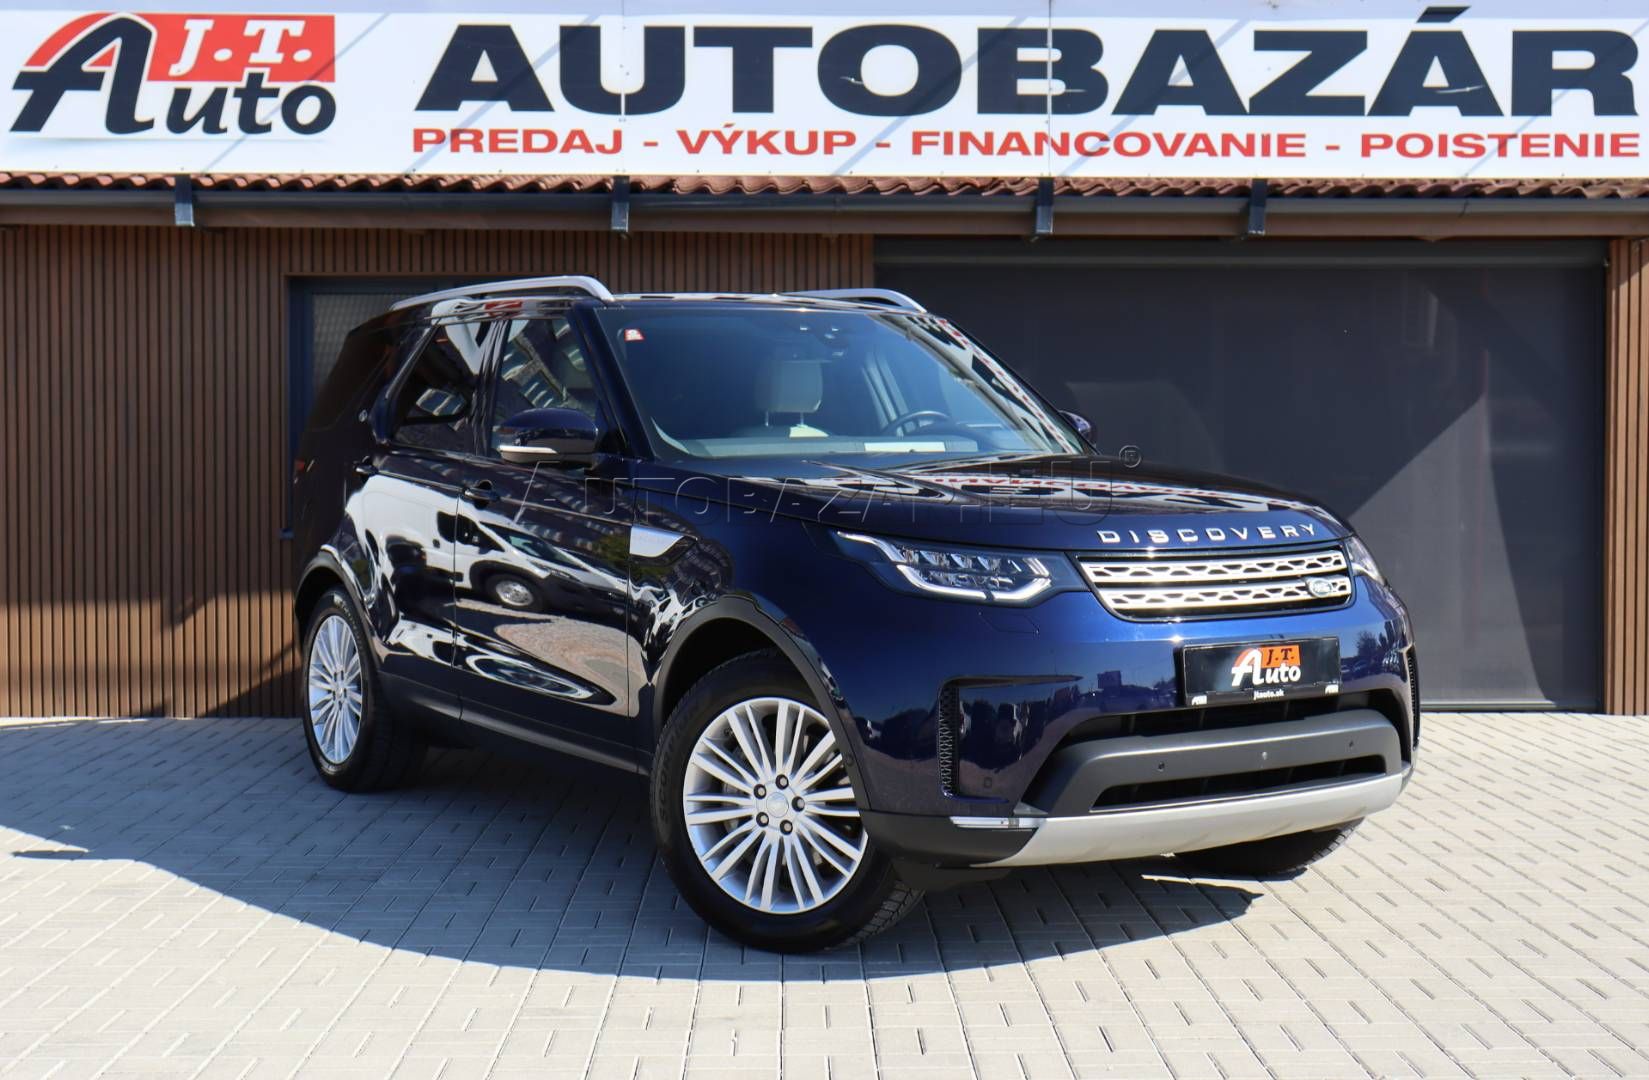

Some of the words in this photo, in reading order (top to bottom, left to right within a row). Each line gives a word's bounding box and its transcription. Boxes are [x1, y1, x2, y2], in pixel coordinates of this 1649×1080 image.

[169, 19, 313, 76] J.T.
[415, 6, 1638, 117] AUTOBAZÁR
[10, 13, 336, 135] Auto
[413, 128, 622, 155] PREDAJ
[676, 124, 857, 156] VÝKUP
[911, 131, 1306, 157] FINANCOVANIE
[1361, 132, 1639, 158] POISTENIE
[1097, 524, 1315, 543] DISCOVERY
[1231, 648, 1301, 687] Auto
[1266, 648, 1295, 665] J.T.
